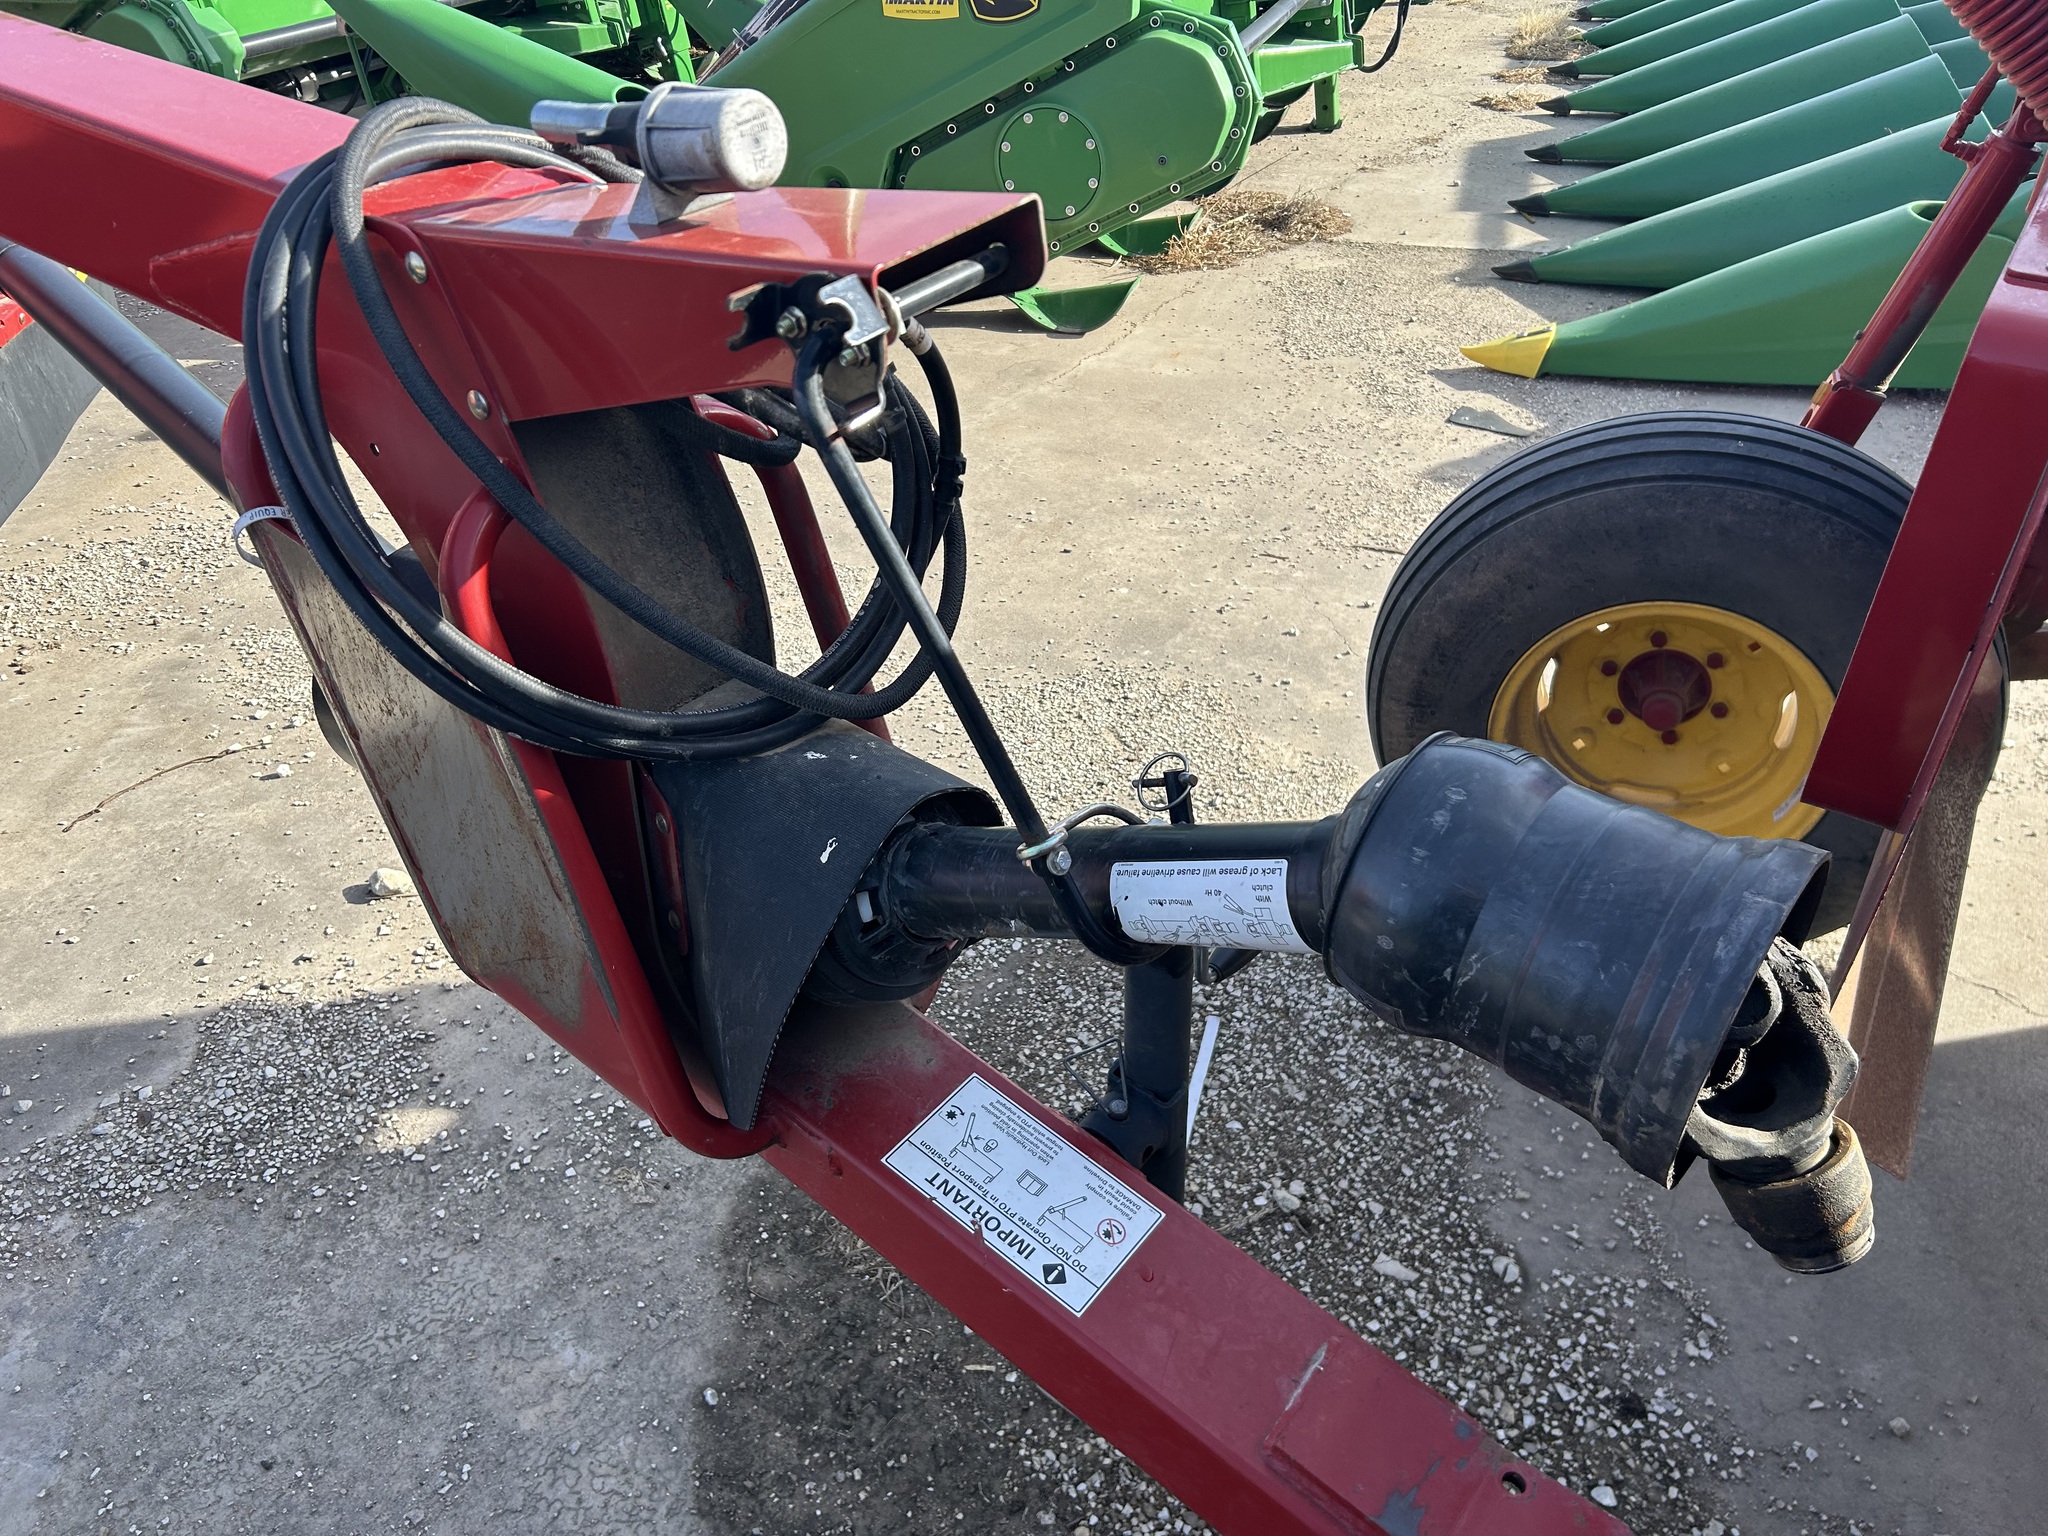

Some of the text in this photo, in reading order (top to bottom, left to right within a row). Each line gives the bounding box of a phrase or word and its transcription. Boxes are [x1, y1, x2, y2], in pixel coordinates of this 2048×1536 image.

[1115, 865, 1282, 878] Lack of grease will cause driveline failure.
[1204, 888, 1222, 897] 40 Hr
[1251, 884, 1273, 892] clutch
[1167, 898, 1193, 906] Without
[1255, 895, 1272, 903] With
[980, 1103, 1002, 1120] position
[999, 1118, 1011, 1129] field
[1020, 1118, 1033, 1129] PTO
[992, 1121, 1050, 1166] Lock Out Hydraulic Valve
[1016, 1130, 1041, 1150] operating
[1033, 1135, 1054, 1151] prevent
[1039, 1148, 1054, 1160] when
[1084, 1182, 1106, 1200] comply
[1103, 1188, 1121, 1203] result
[919, 1140, 1088, 1273] DO NOT Operate PTO in Transport Position
[1106, 1198, 1113, 1206] to
[1114, 1188, 1142, 1211] DAMAGE
[1113, 1204, 1133, 1221] Failure
[1119, 1201, 1137, 1215] could
[923, 1171, 1036, 1260] IMPORTANT
